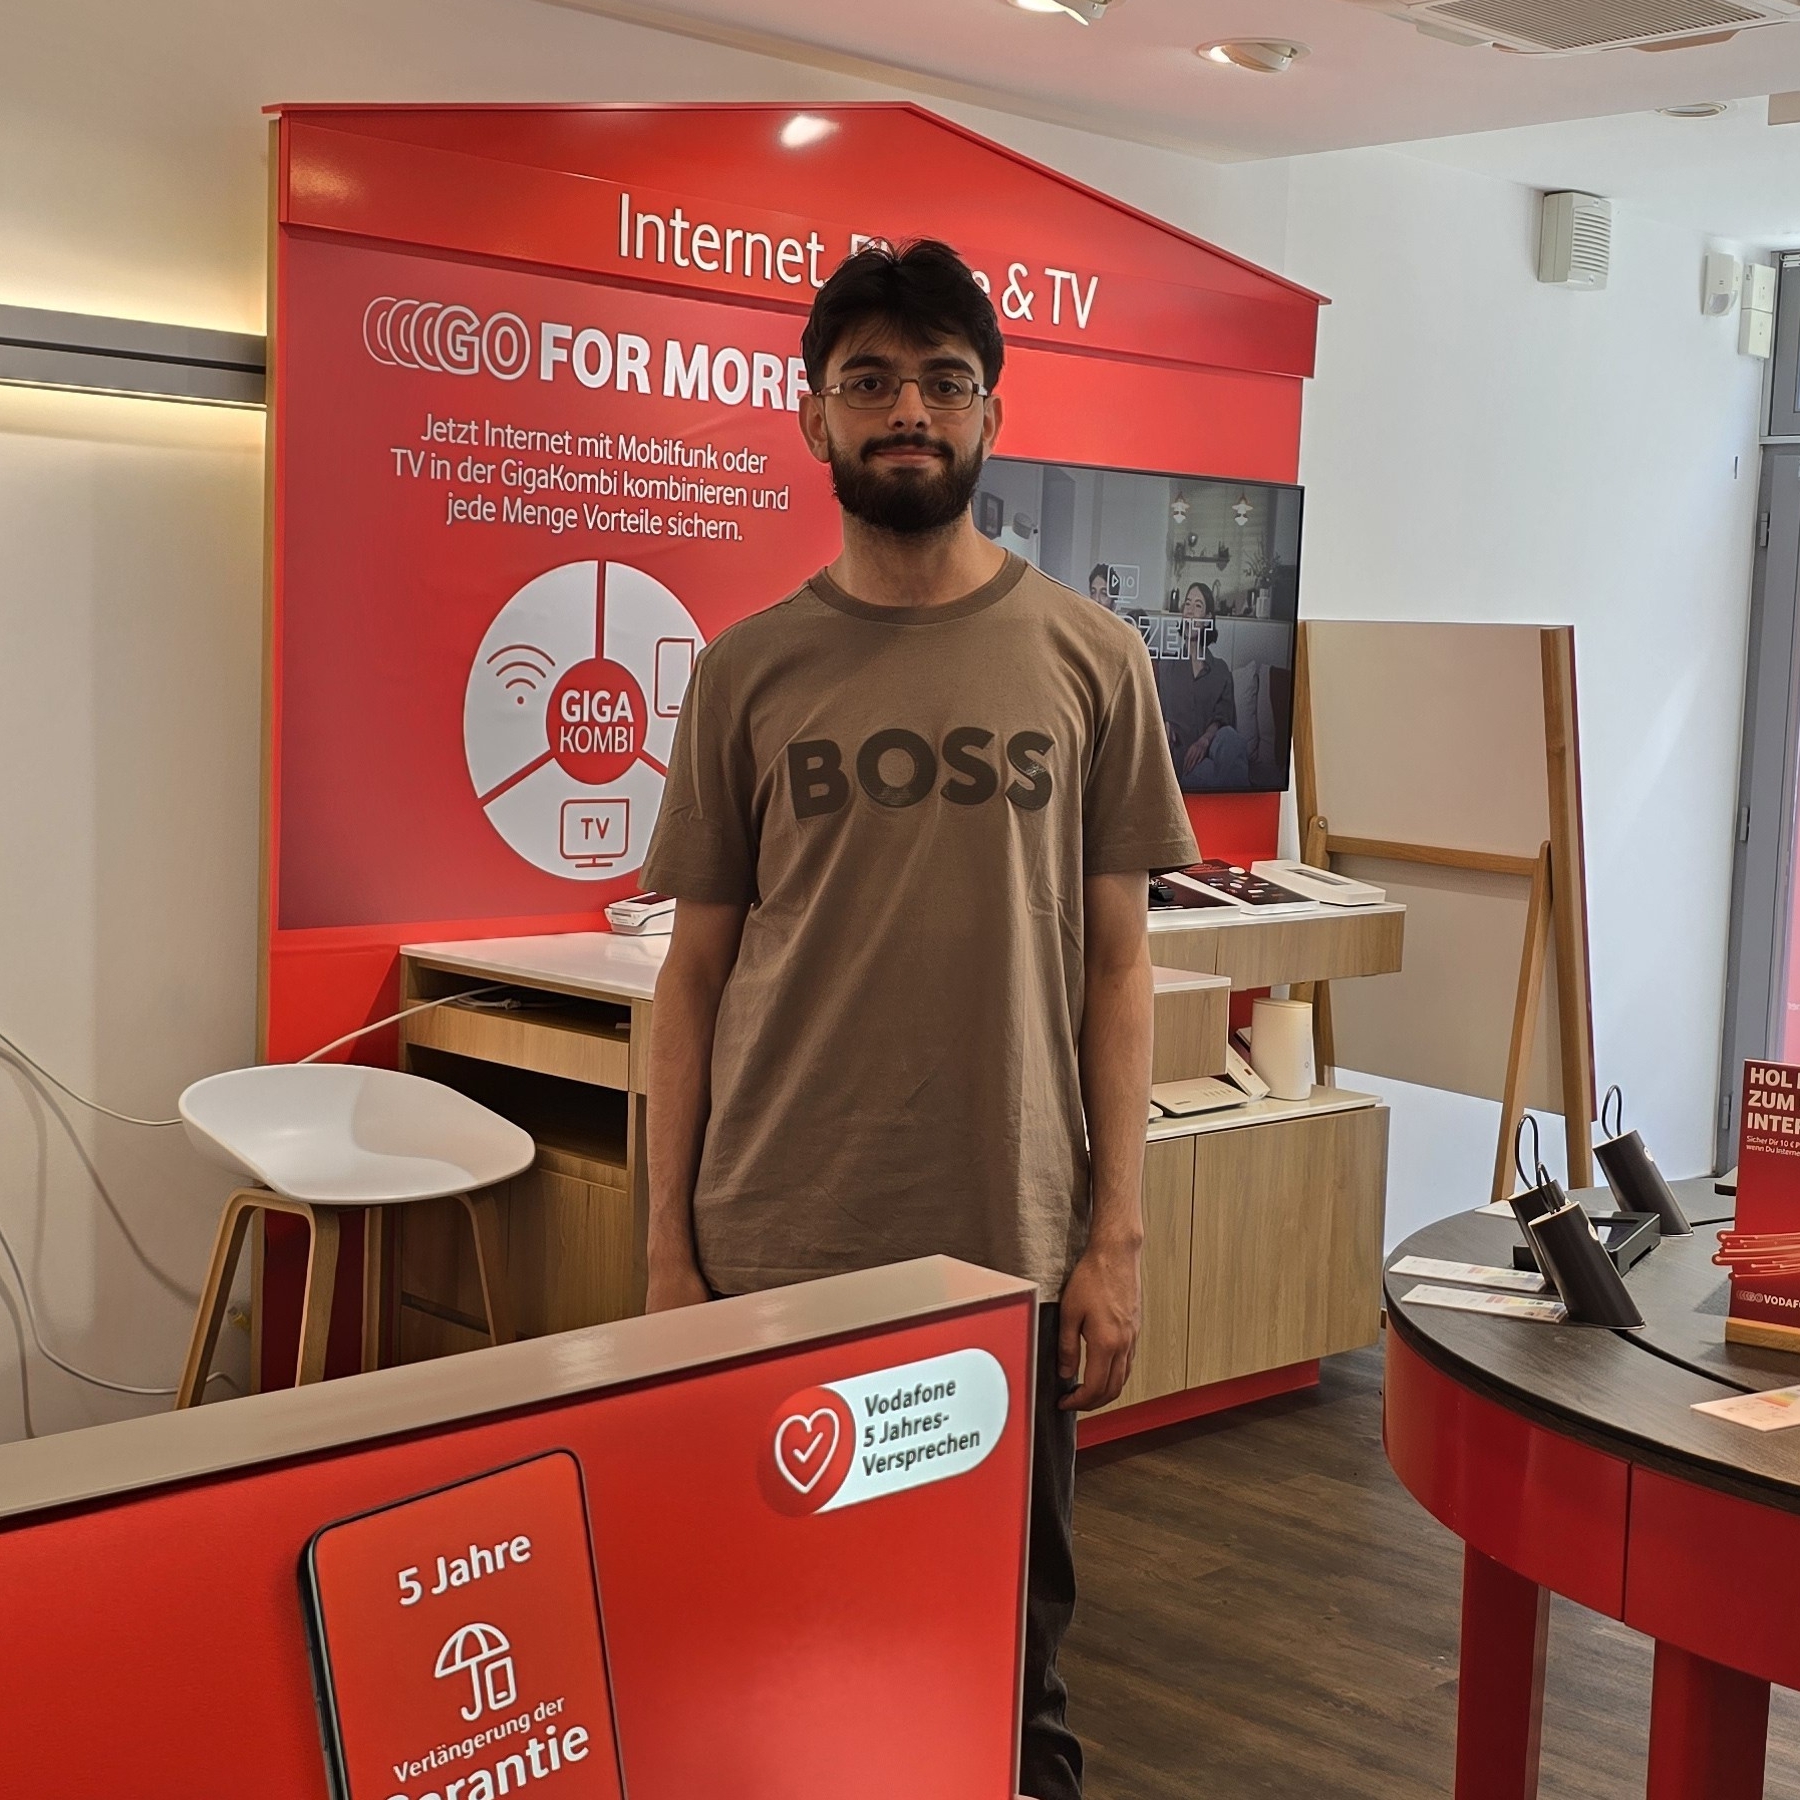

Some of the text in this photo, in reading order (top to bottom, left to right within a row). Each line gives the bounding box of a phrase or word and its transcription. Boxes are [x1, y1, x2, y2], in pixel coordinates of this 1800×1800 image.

[1001, 262, 1034, 321] &
[1044, 267, 1099, 329] TV
[540, 322, 651, 394] FOR
[421, 413, 768, 474] Jetzt Internet mit Mobilfunk oder
[390, 448, 789, 510] TV in der GigaKombi kombinieren und
[446, 492, 744, 541] jede Menge Vorteile sichern.
[1122, 615, 1214, 660] ZEIT
[560, 690, 634, 723] GIGA
[559, 726, 634, 753] KOMBI
[787, 726, 1056, 821] BOSS
[580, 817, 610, 840] TV
[1748, 1089, 1795, 1111] ZUM
[1750, 1067, 1792, 1089] HOL
[1746, 1135, 1768, 1145] Sicher
[1768, 1138, 1779, 1146] Dir
[1780, 1139, 1789, 1147] 10
[1746, 1144, 1765, 1152] wenn
[1765, 1145, 1775, 1153] Du
[1763, 1294, 1800, 1309] VODAF
[864, 1379, 956, 1417] Vodafone
[863, 1411, 950, 1448] 5 Jahres-
[862, 1430, 980, 1476] Versprechen
[398, 1535, 531, 1606] 5 Jahre
[393, 1697, 564, 1782] Verlängerung der
[386, 1725, 589, 1800] rantie
